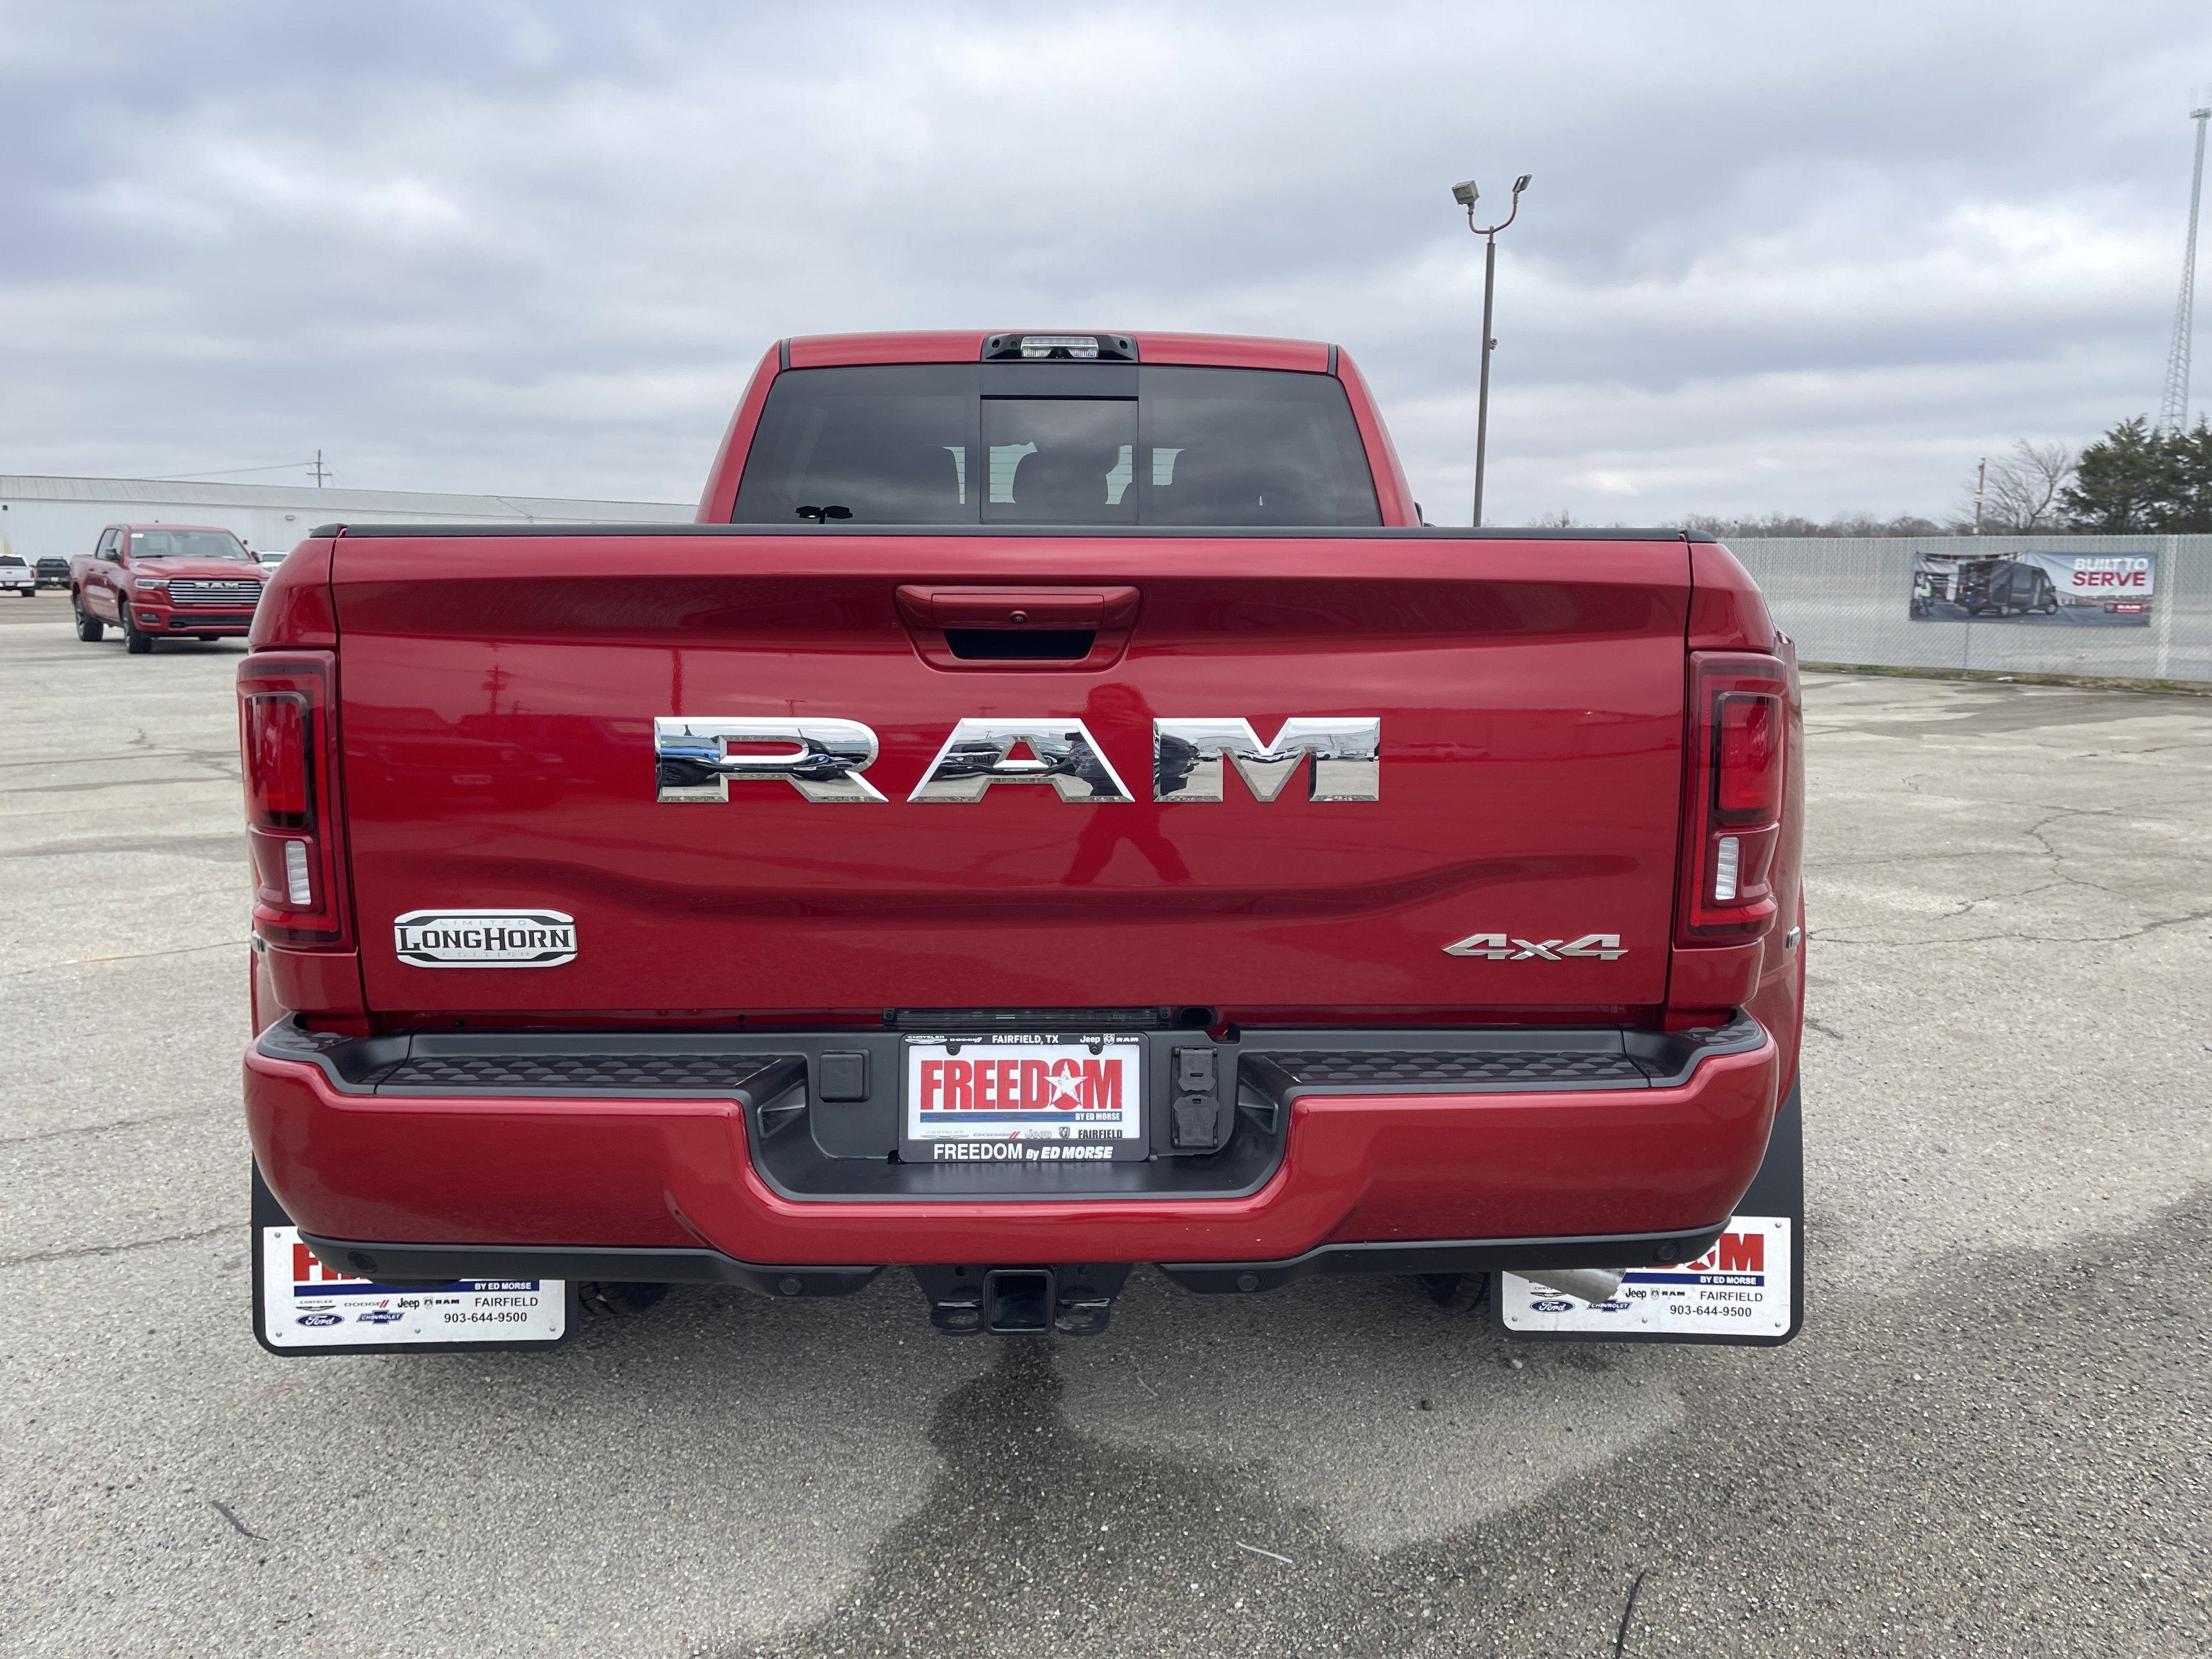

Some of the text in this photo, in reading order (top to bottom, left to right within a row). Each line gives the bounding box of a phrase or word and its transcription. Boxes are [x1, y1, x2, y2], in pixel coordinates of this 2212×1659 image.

[2074, 557, 2149, 571] BUILT TO
[2072, 571, 2146, 586] SERVE
[653, 716, 1381, 803] RAM
[1441, 933, 1630, 961] 4x4
[992, 1035, 1059, 1045] FAIRFIELD, TX
[1080, 1035, 1101, 1044] Jeep
[920, 1058, 1122, 1110] FREEDOM
[1024, 1129, 1052, 1139] Jeep
[1078, 1129, 1123, 1138] FAIRFIELD
[934, 1143, 1114, 1161] FREEDOM By ED MORSE
[475, 1282, 487, 1290] BY
[501, 1282, 532, 1290] MORSE
[1700, 1276, 1757, 1285] BY ED MORSE
[1626, 1288, 1646, 1300] Jeep
[1700, 1291, 1763, 1302] FAIRFIELD
[397, 1298, 420, 1310] Jeep
[475, 1297, 538, 1307] FAIRFIELD
[1539, 1301, 1566, 1311] Ford
[1670, 1305, 1752, 1317] 903-644-9500
[304, 1315, 335, 1325] Ford
[444, 1312, 527, 1323] 903-644-9500
